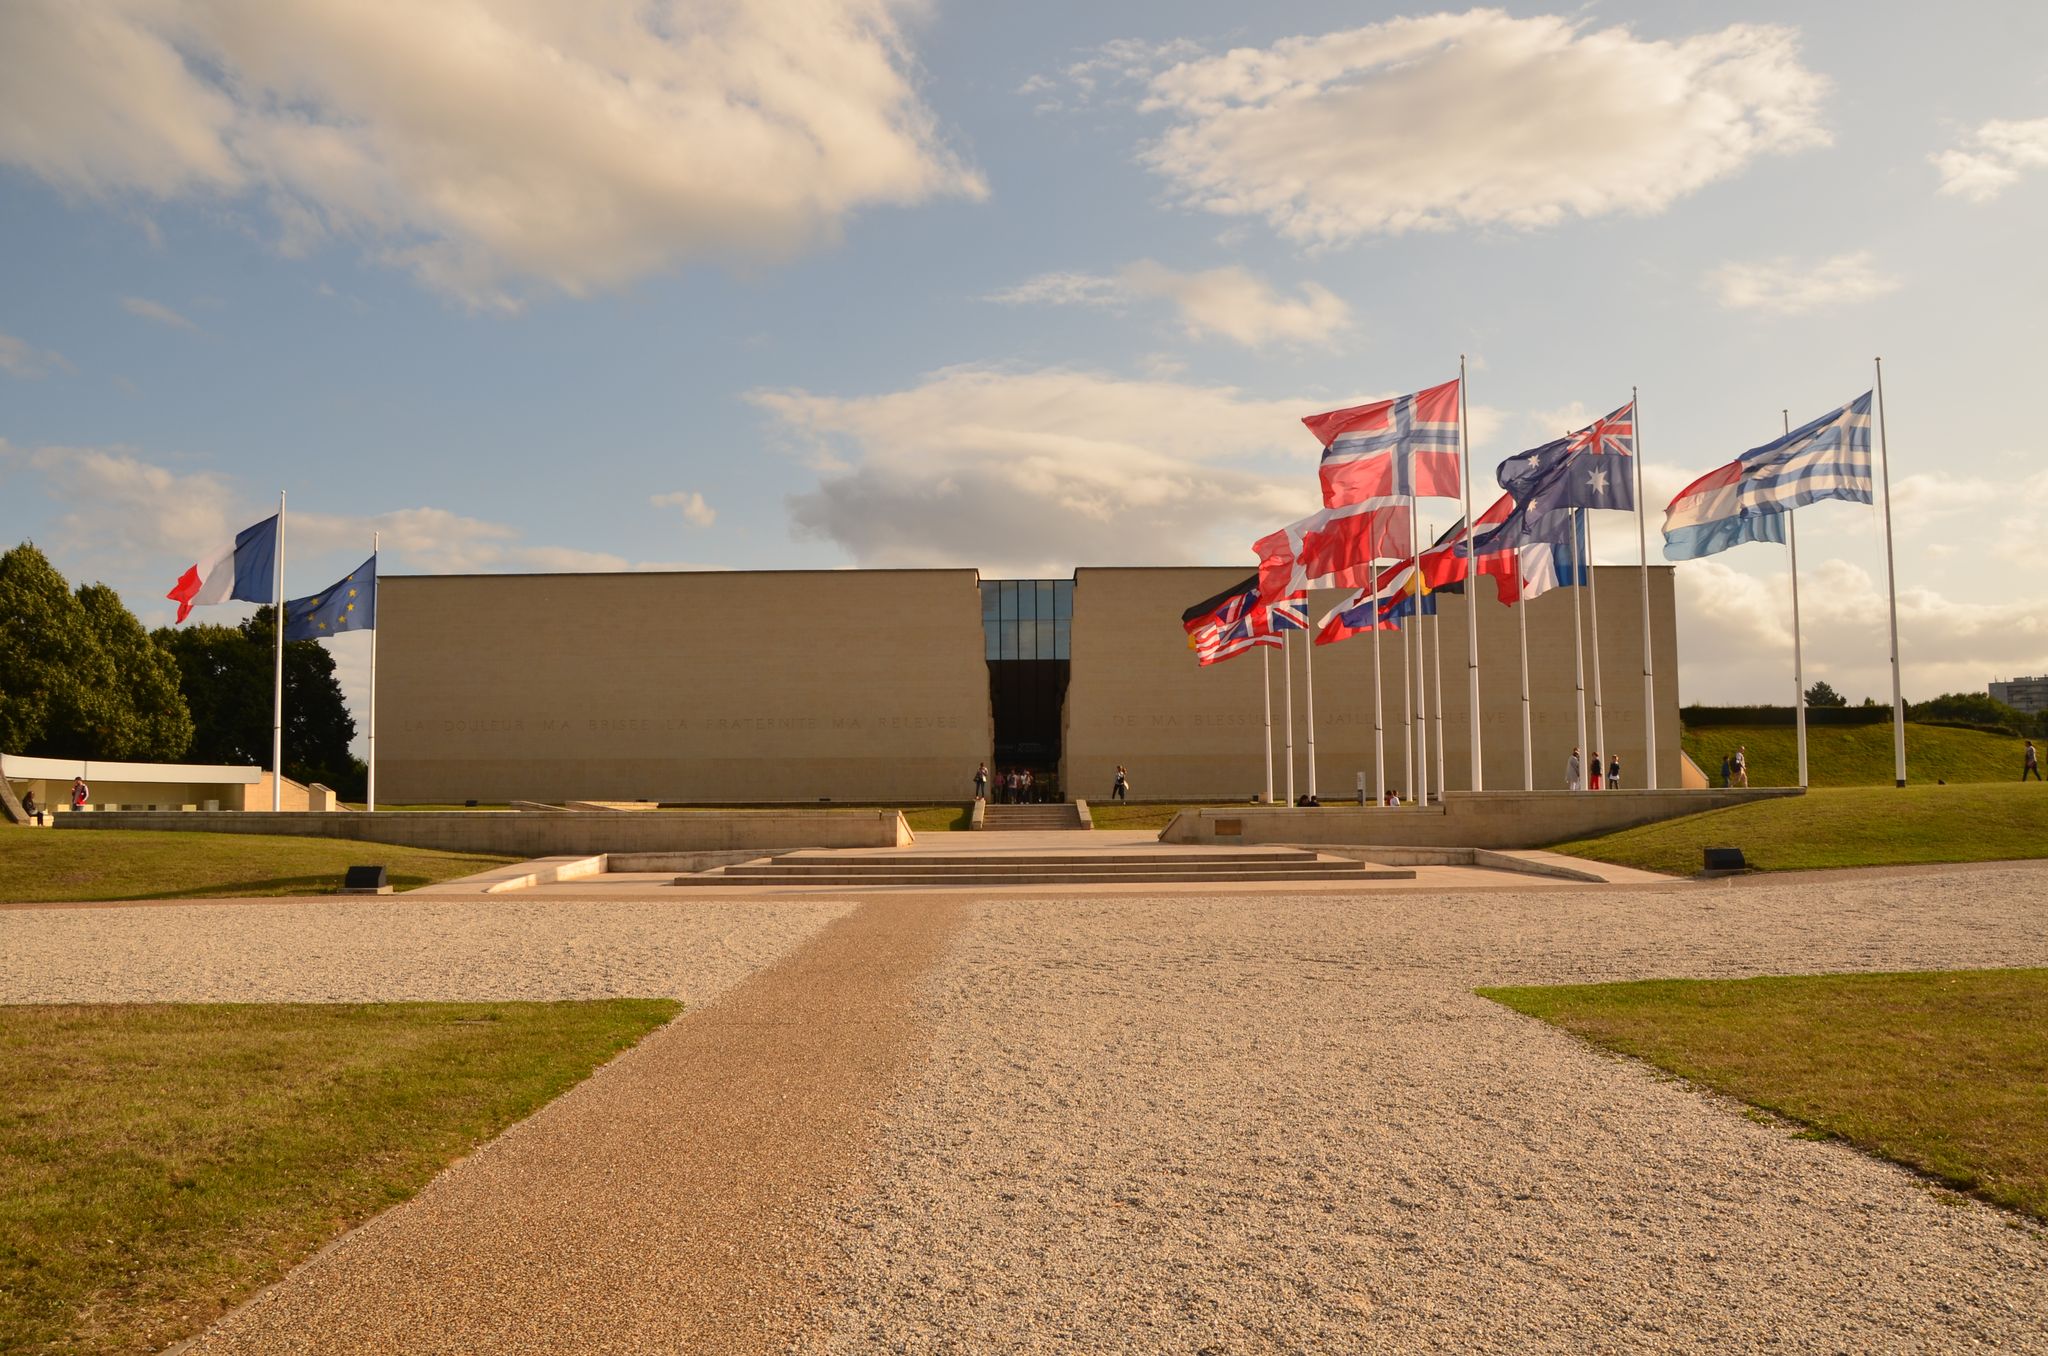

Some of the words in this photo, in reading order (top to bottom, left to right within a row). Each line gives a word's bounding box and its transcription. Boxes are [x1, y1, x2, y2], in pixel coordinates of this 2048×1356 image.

[403, 719, 424, 732] LA
[443, 719, 524, 732] DOULEUR
[666, 719, 688, 730] LA
[1151, 715, 1176, 726] MA
[1323, 713, 1376, 725] JAILL
